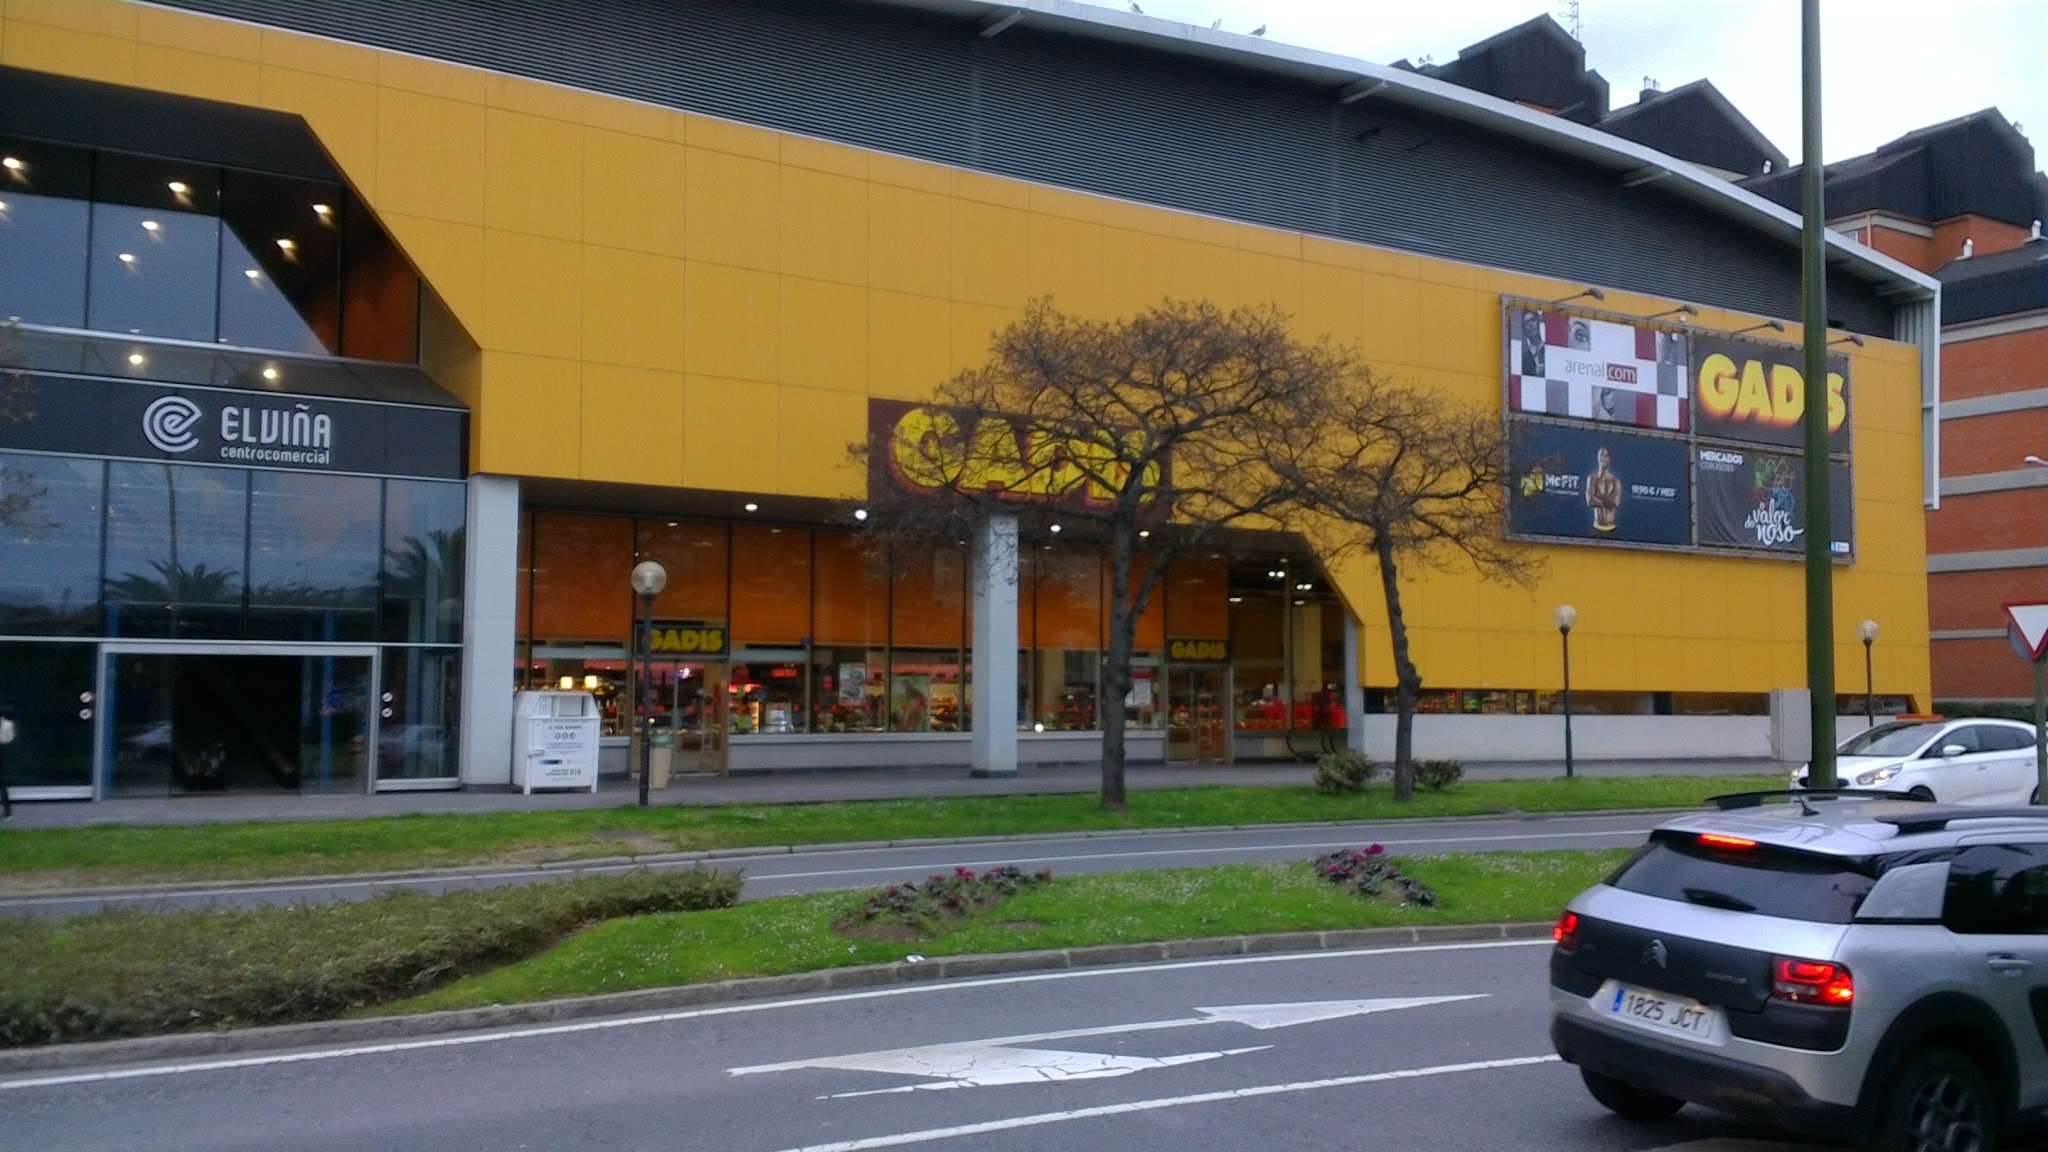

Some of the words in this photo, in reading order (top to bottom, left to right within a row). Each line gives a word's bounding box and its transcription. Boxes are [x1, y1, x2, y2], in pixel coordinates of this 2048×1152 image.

[1698, 353, 1846, 434] GADS
[220, 404, 331, 449] ELVIÑA
[220, 447, 330, 465] centrocomercial
[1700, 451, 1743, 465] MERCADOS
[1752, 497, 1791, 525] valor
[1170, 640, 1227, 660] GADIS
[1626, 994, 1665, 1021] 1825
[1669, 1006, 1704, 1031] JCT
